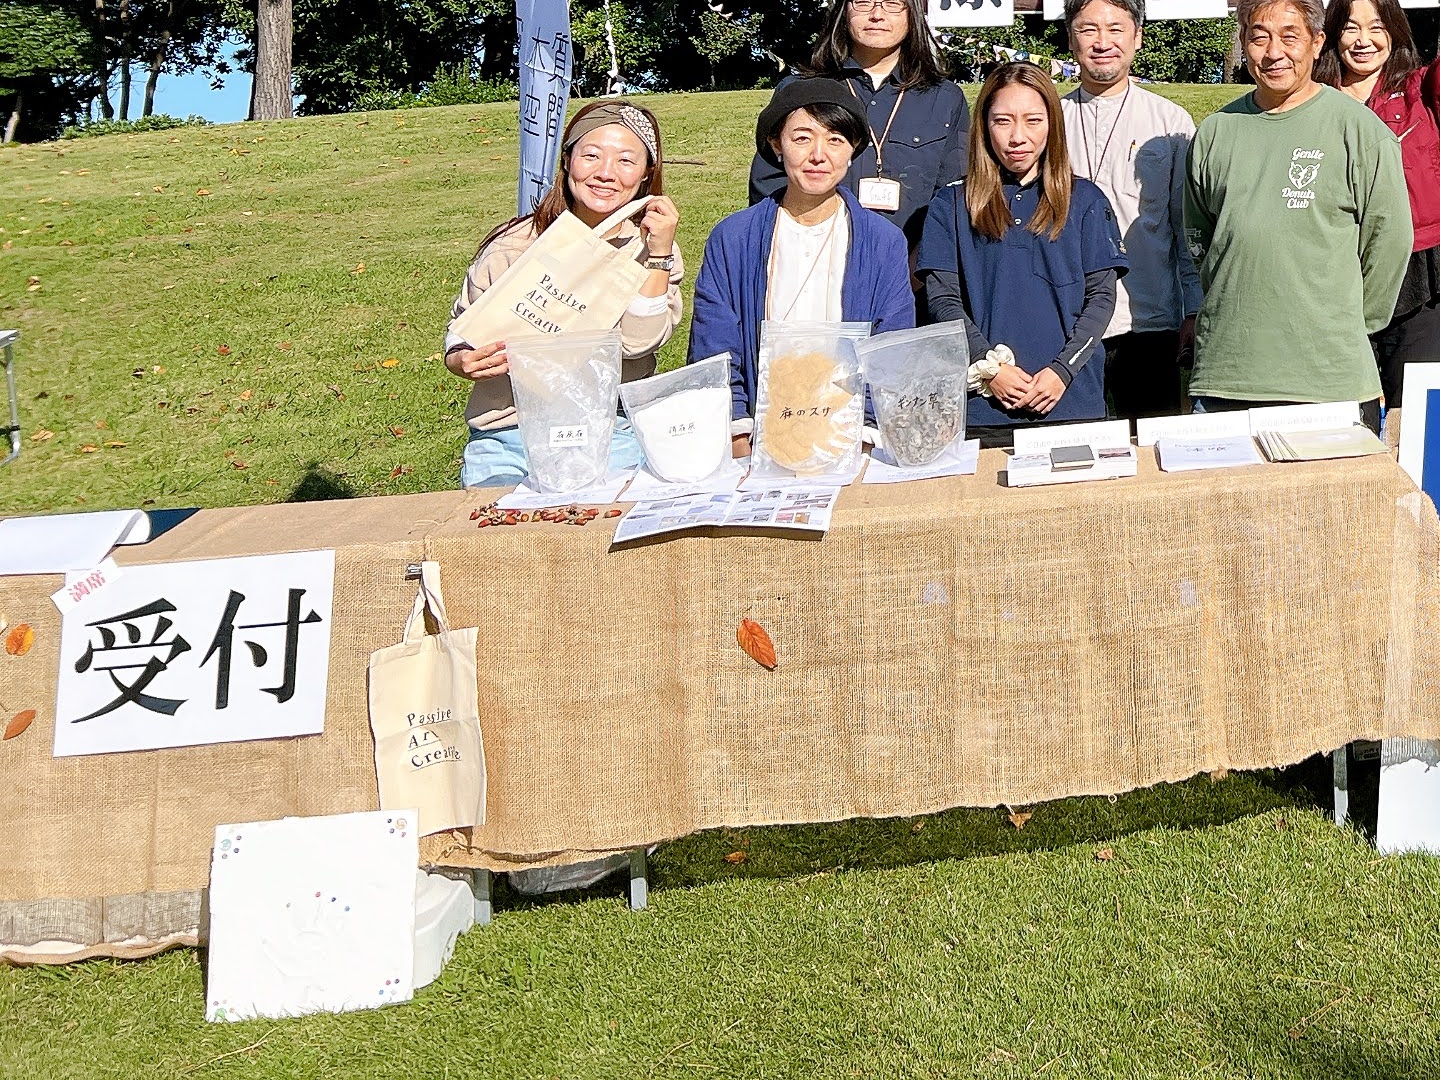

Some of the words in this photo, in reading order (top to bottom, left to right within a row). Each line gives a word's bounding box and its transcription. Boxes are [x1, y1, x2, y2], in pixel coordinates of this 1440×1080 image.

[526, 289, 548, 309] Art
[539, 273, 587, 313] Passive
[515, 302, 562, 333] Creativ
[71, 588, 323, 724] 受付
[406, 707, 451, 727] Passive
[408, 730, 439, 749] Ar
